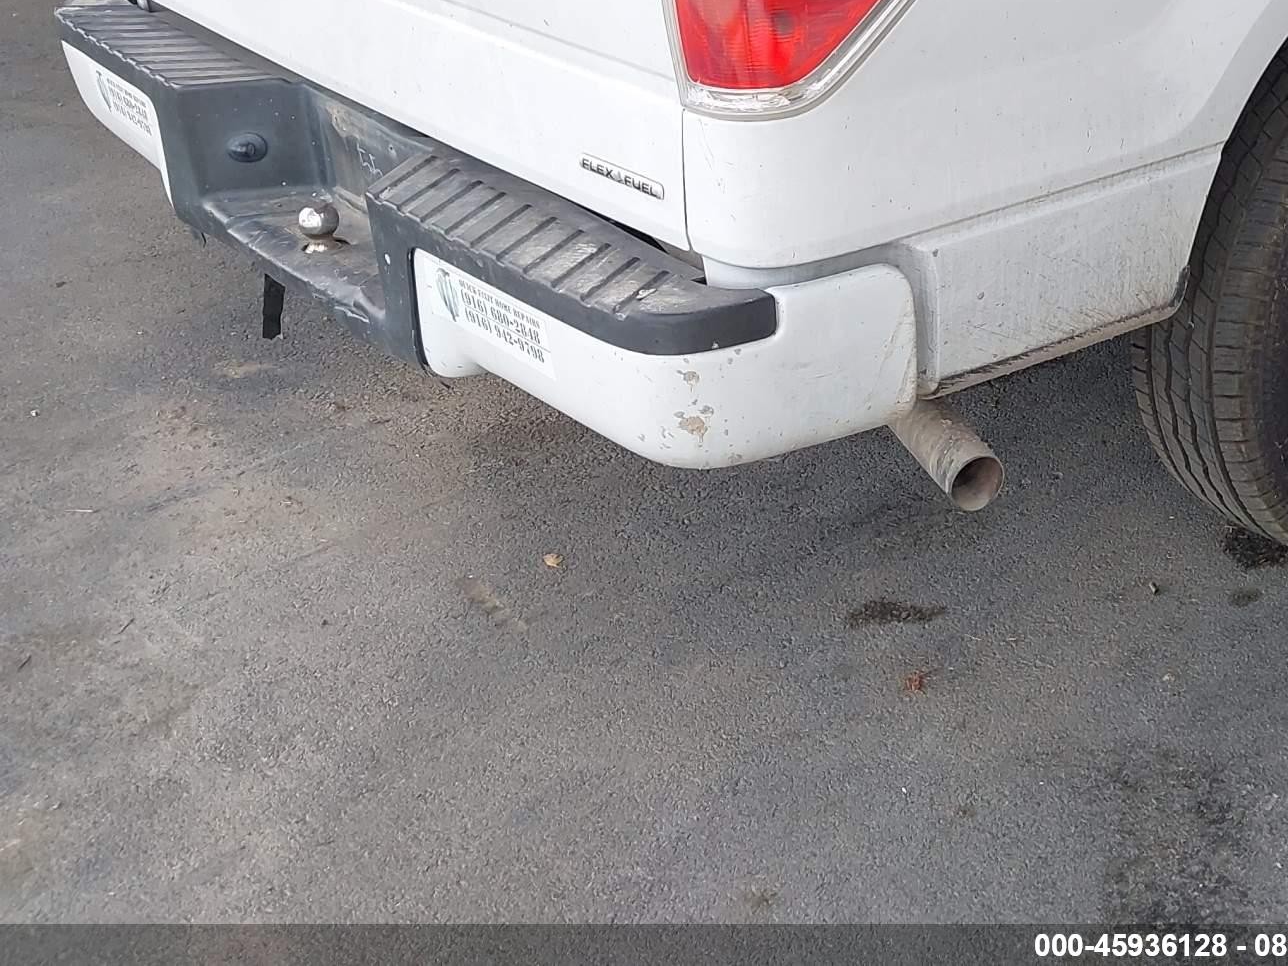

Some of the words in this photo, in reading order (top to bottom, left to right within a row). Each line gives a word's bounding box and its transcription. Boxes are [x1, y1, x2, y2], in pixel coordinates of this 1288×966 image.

[460, 288, 488, 316] (916)
[490, 306, 541, 345] 680-2848
[464, 306, 493, 334] (916)
[494, 324, 546, 364] 942-9798
